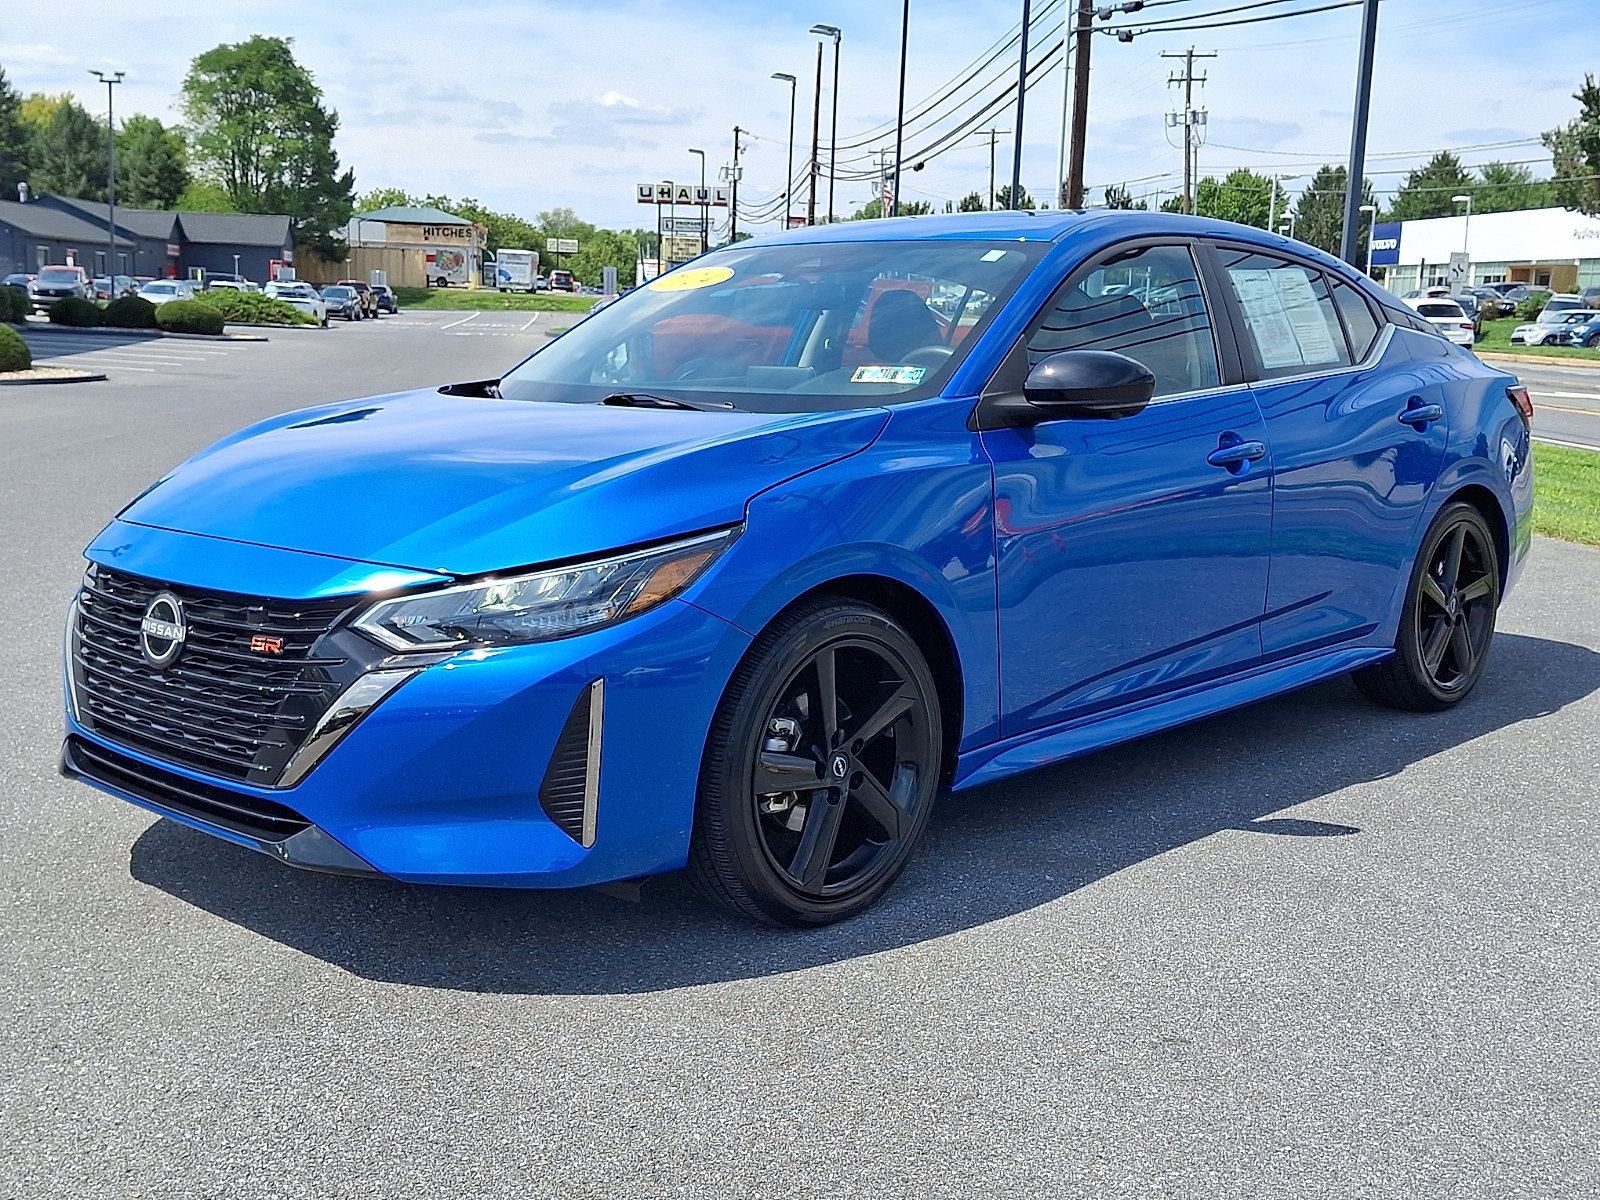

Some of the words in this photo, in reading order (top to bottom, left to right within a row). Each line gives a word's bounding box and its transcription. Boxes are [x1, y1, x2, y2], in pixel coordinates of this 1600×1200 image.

[423, 226, 472, 238] HITCHES
[1372, 239, 1397, 250] VOLVO
[141, 618, 184, 639] NISSAN
[251, 635, 282, 655] SR
